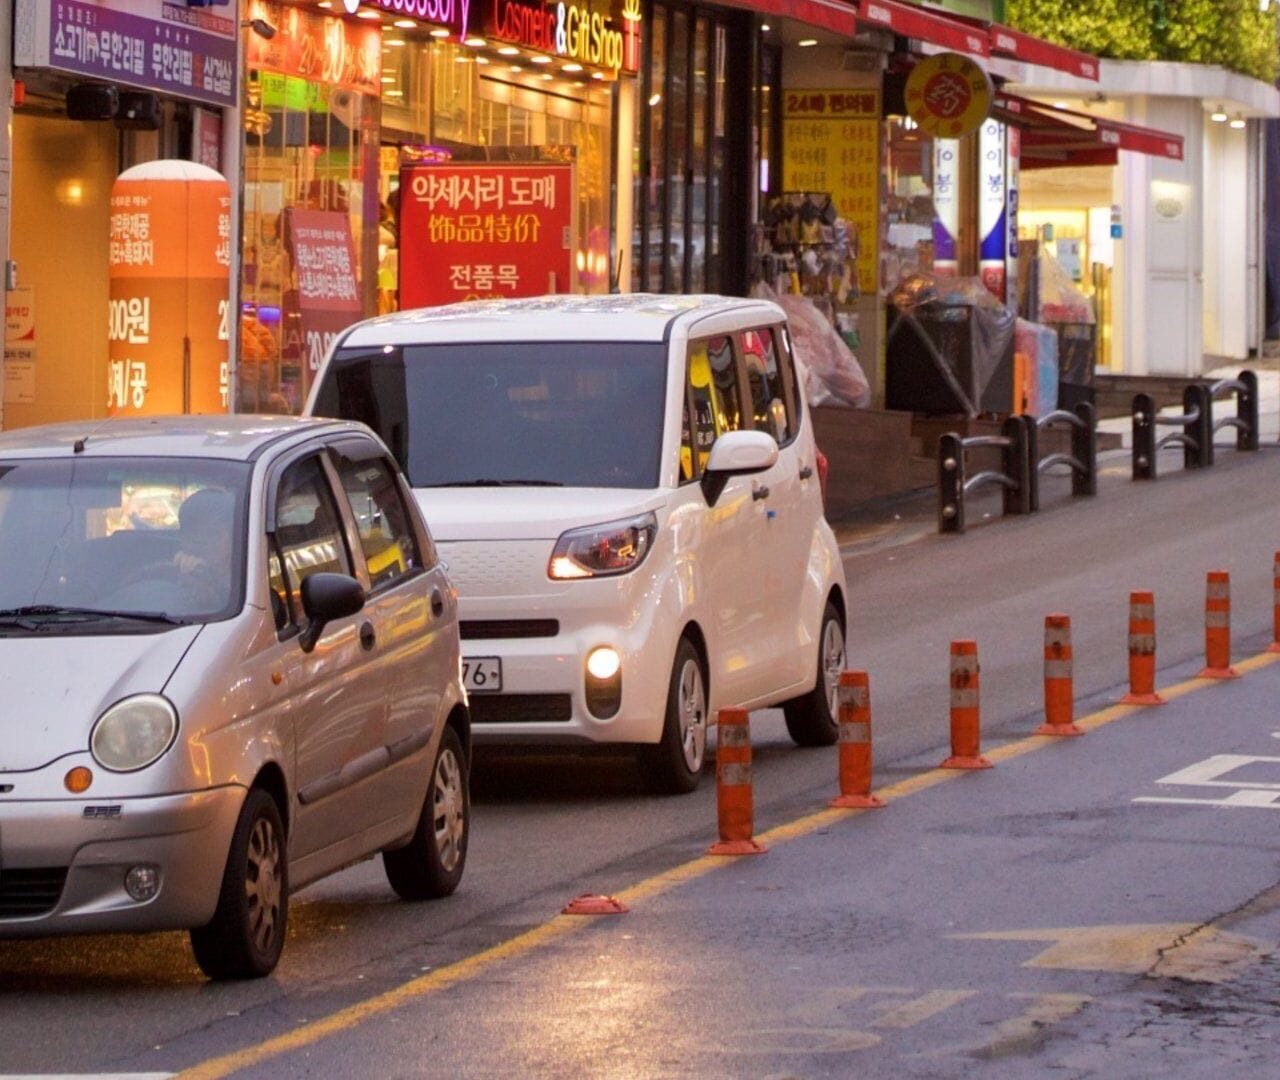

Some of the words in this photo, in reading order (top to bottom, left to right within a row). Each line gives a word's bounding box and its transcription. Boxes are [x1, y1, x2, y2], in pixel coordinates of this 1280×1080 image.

[555, 1, 568, 55] &
[567, 4, 591, 59] Gift
[591, 10, 624, 71] Shop
[412, 173, 505, 211] 악세사리
[508, 174, 556, 210] 도매
[428, 213, 542, 244] 饰品特价
[449, 264, 520, 290] 전품목
